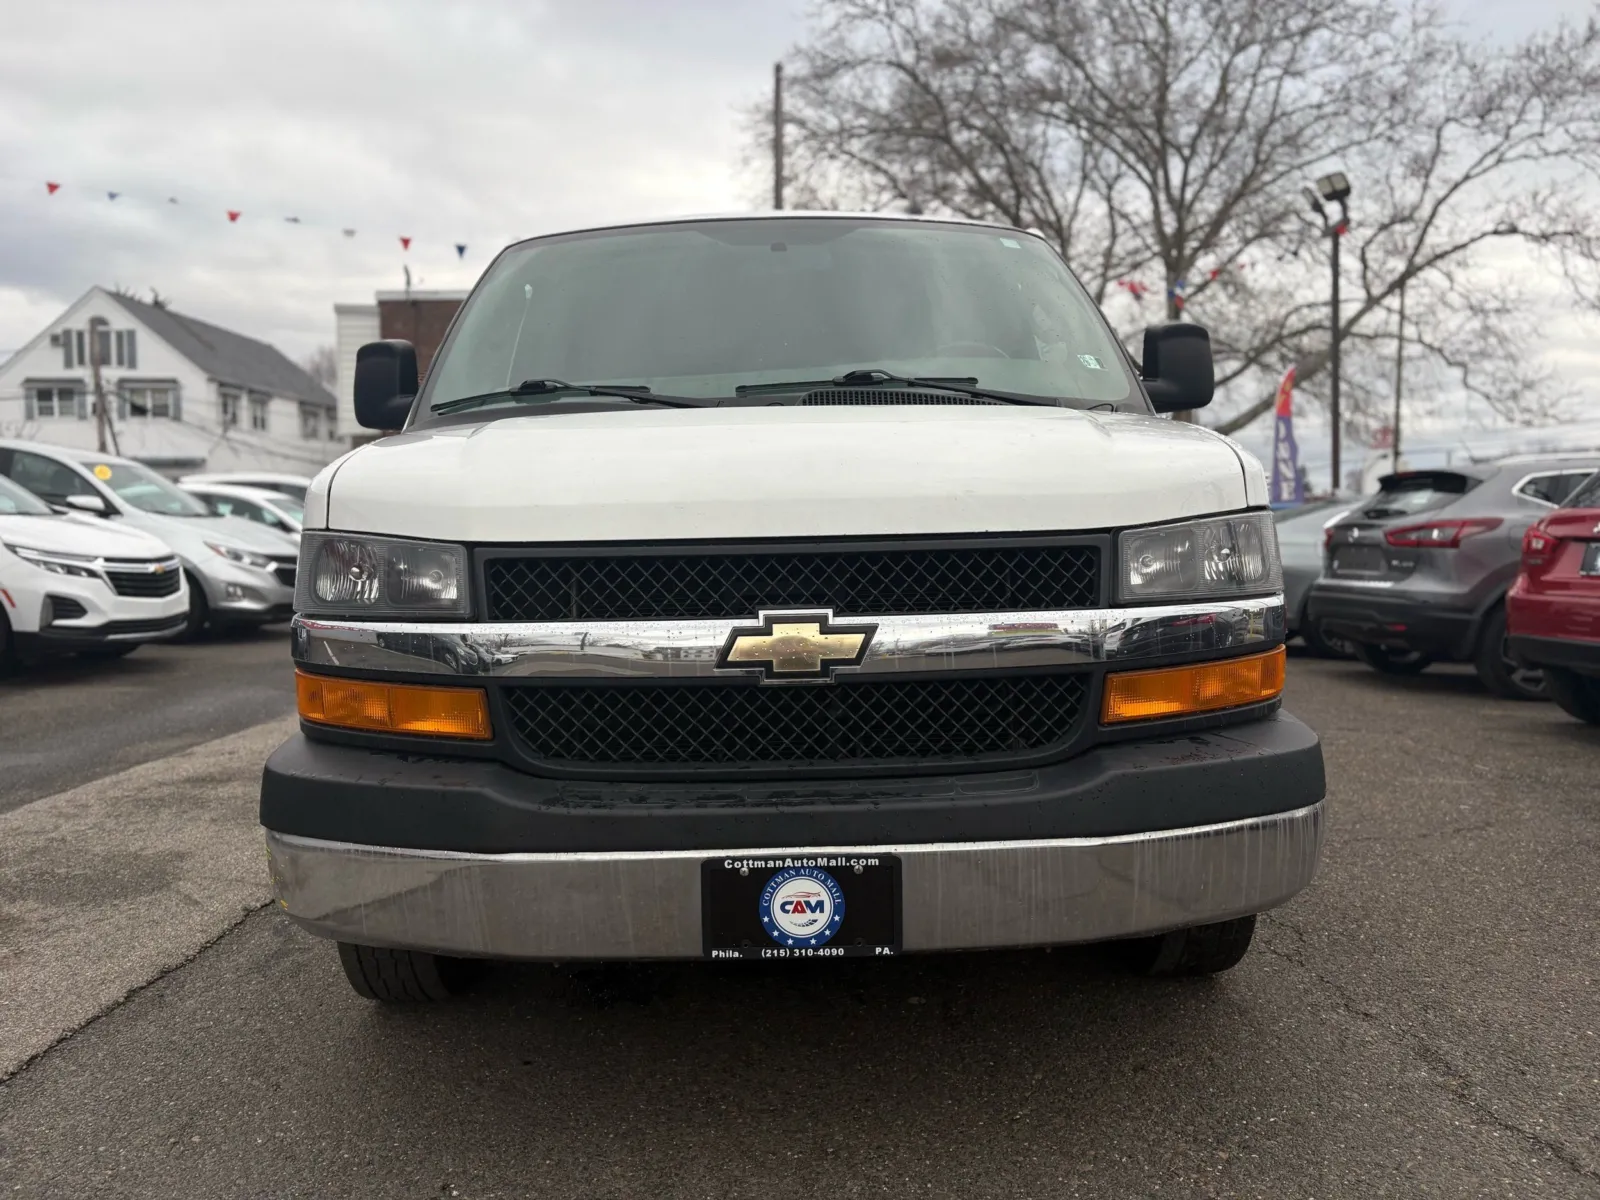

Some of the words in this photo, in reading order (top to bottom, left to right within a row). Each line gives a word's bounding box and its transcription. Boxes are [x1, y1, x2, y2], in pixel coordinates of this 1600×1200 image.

[724, 857, 880, 869] CottmanAutoMall.com
[762, 868, 797, 906] COTTMAN
[799, 868, 825, 881] AUTO
[825, 879, 842, 905] MALL
[779, 899, 825, 914] CAM
[711, 949, 744, 958] Phila.
[761, 948, 790, 958] (215)
[793, 947, 845, 957] 310-4090
[875, 946, 894, 955] PA.
